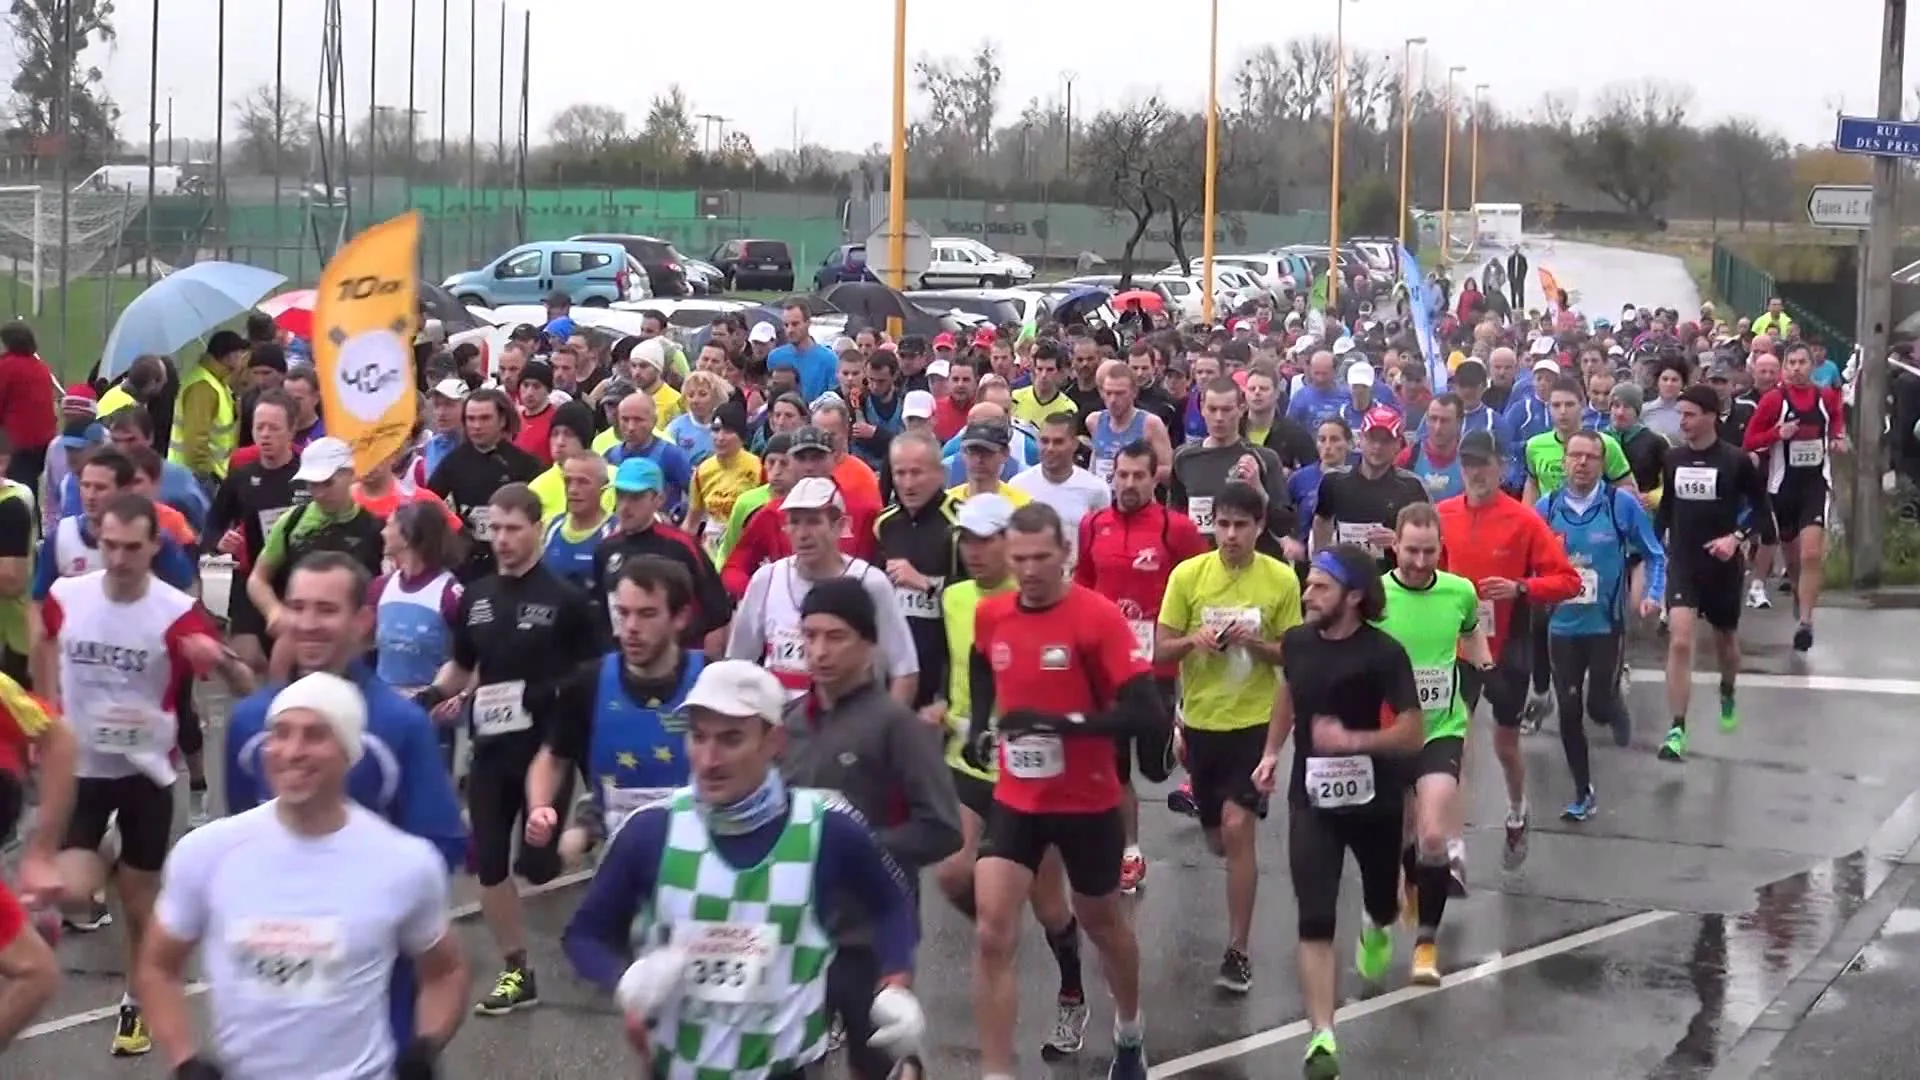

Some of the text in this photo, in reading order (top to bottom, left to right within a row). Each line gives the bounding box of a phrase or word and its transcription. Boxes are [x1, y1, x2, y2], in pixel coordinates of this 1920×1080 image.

[1876, 125, 1902, 137] RUE
[1856, 137, 1880, 149] DES
[1320, 780, 1358, 798] 200
